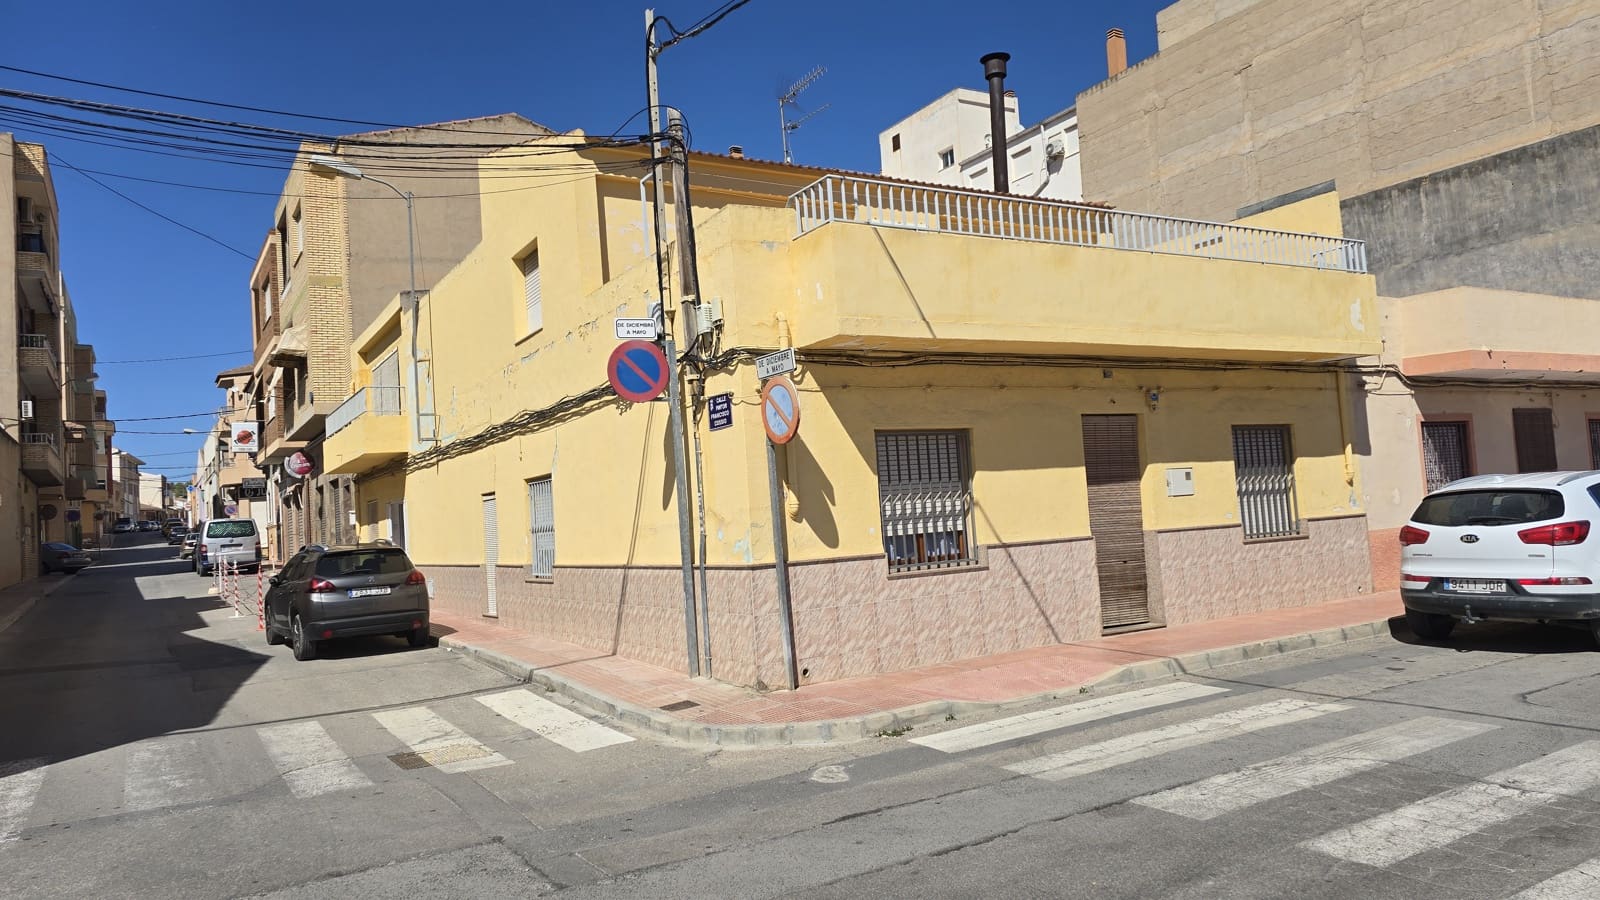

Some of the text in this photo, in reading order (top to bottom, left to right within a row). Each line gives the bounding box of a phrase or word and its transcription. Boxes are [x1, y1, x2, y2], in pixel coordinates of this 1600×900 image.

[758, 351, 790, 368] DE DICIEMBRE
[771, 362, 785, 373] MAYO
[1451, 579, 1503, 591] 9411 JDR
